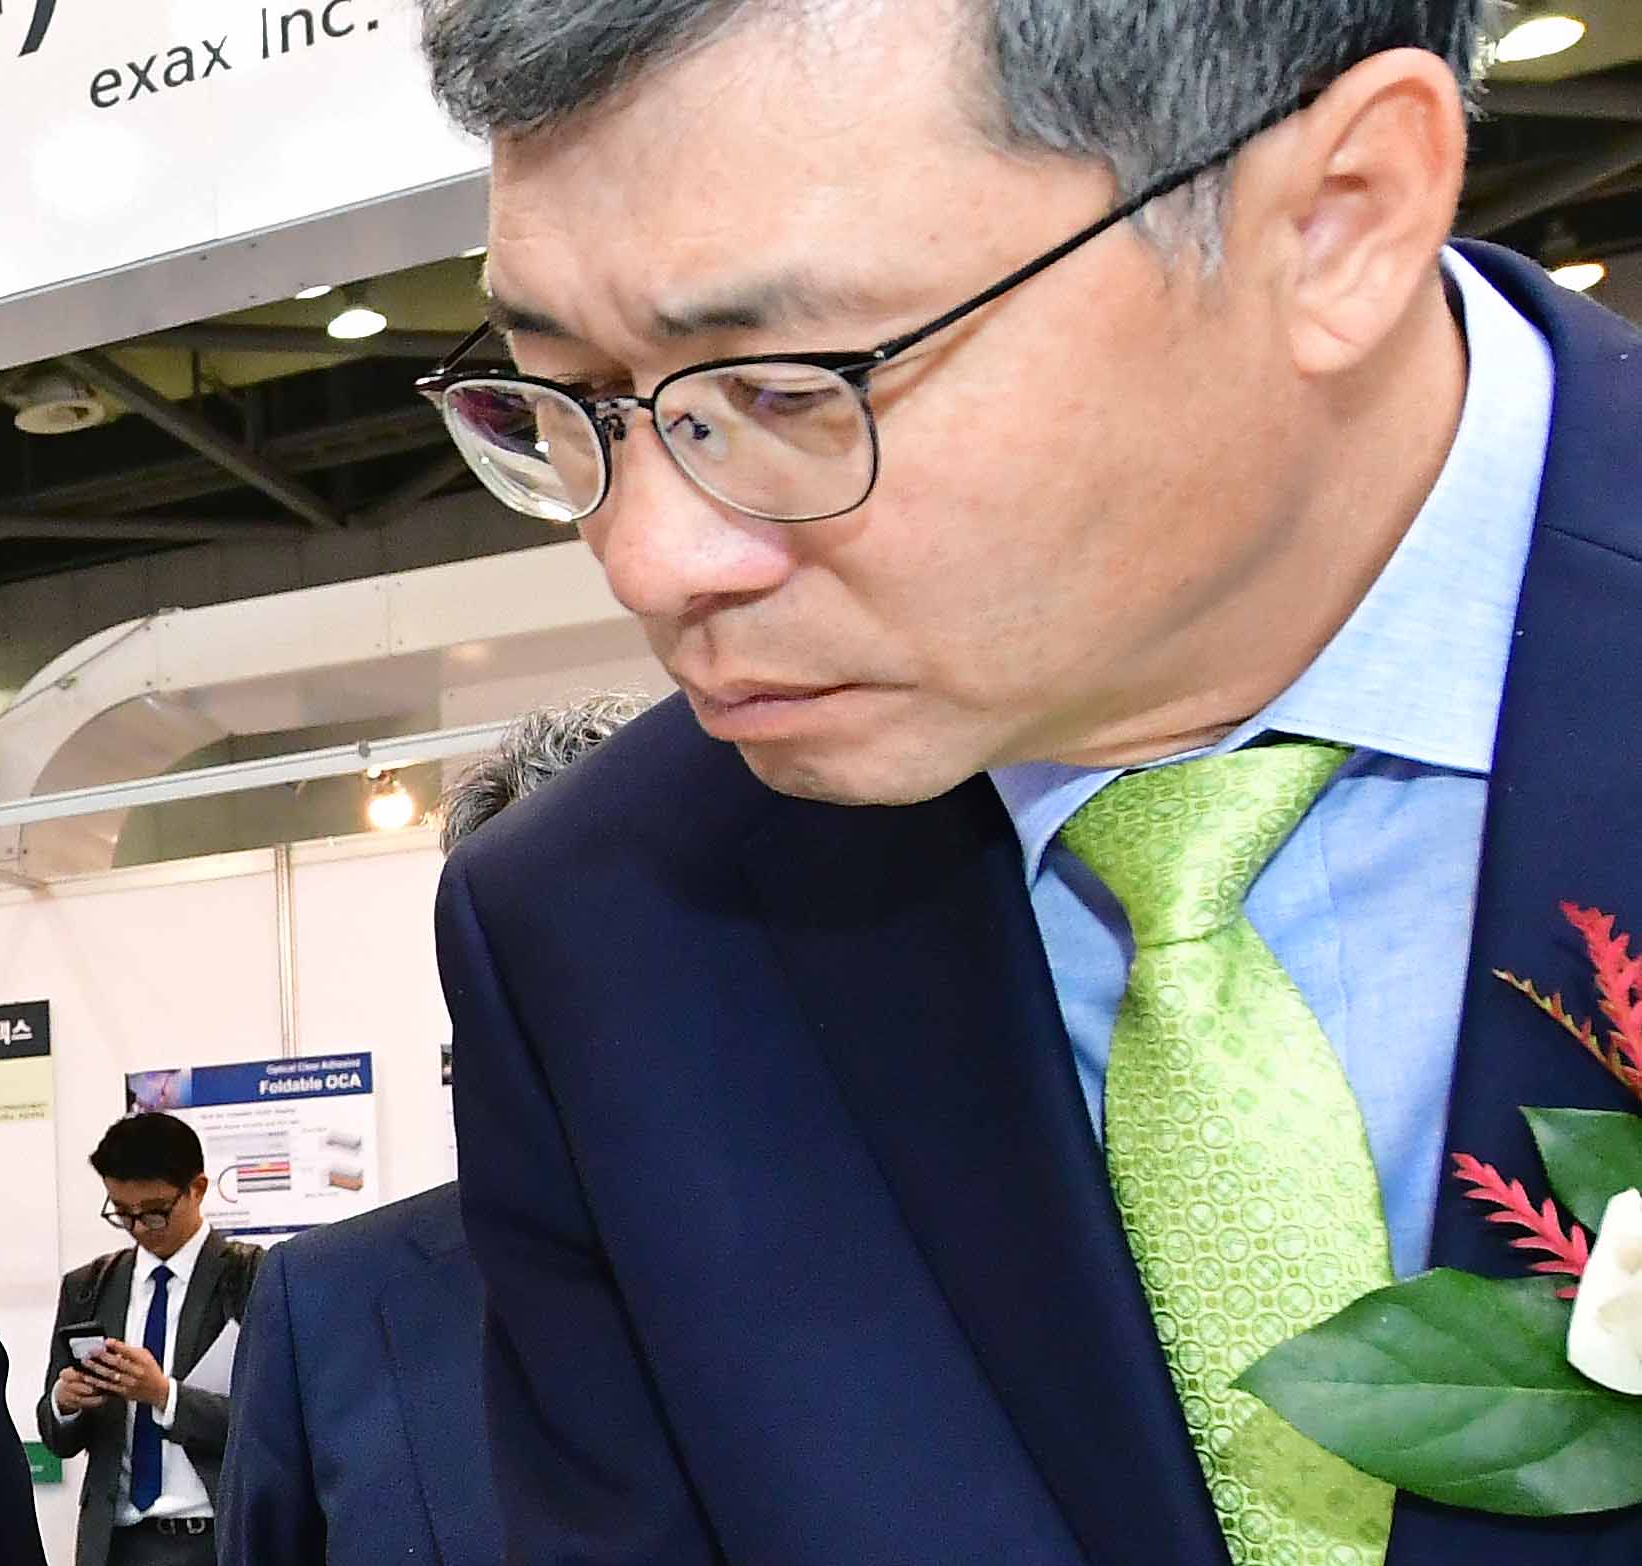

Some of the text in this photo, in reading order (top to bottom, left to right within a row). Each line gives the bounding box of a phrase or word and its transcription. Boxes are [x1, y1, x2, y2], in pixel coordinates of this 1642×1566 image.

[89, 0, 379, 109] exax Inc.
[325, 1072, 362, 1089] OCA
